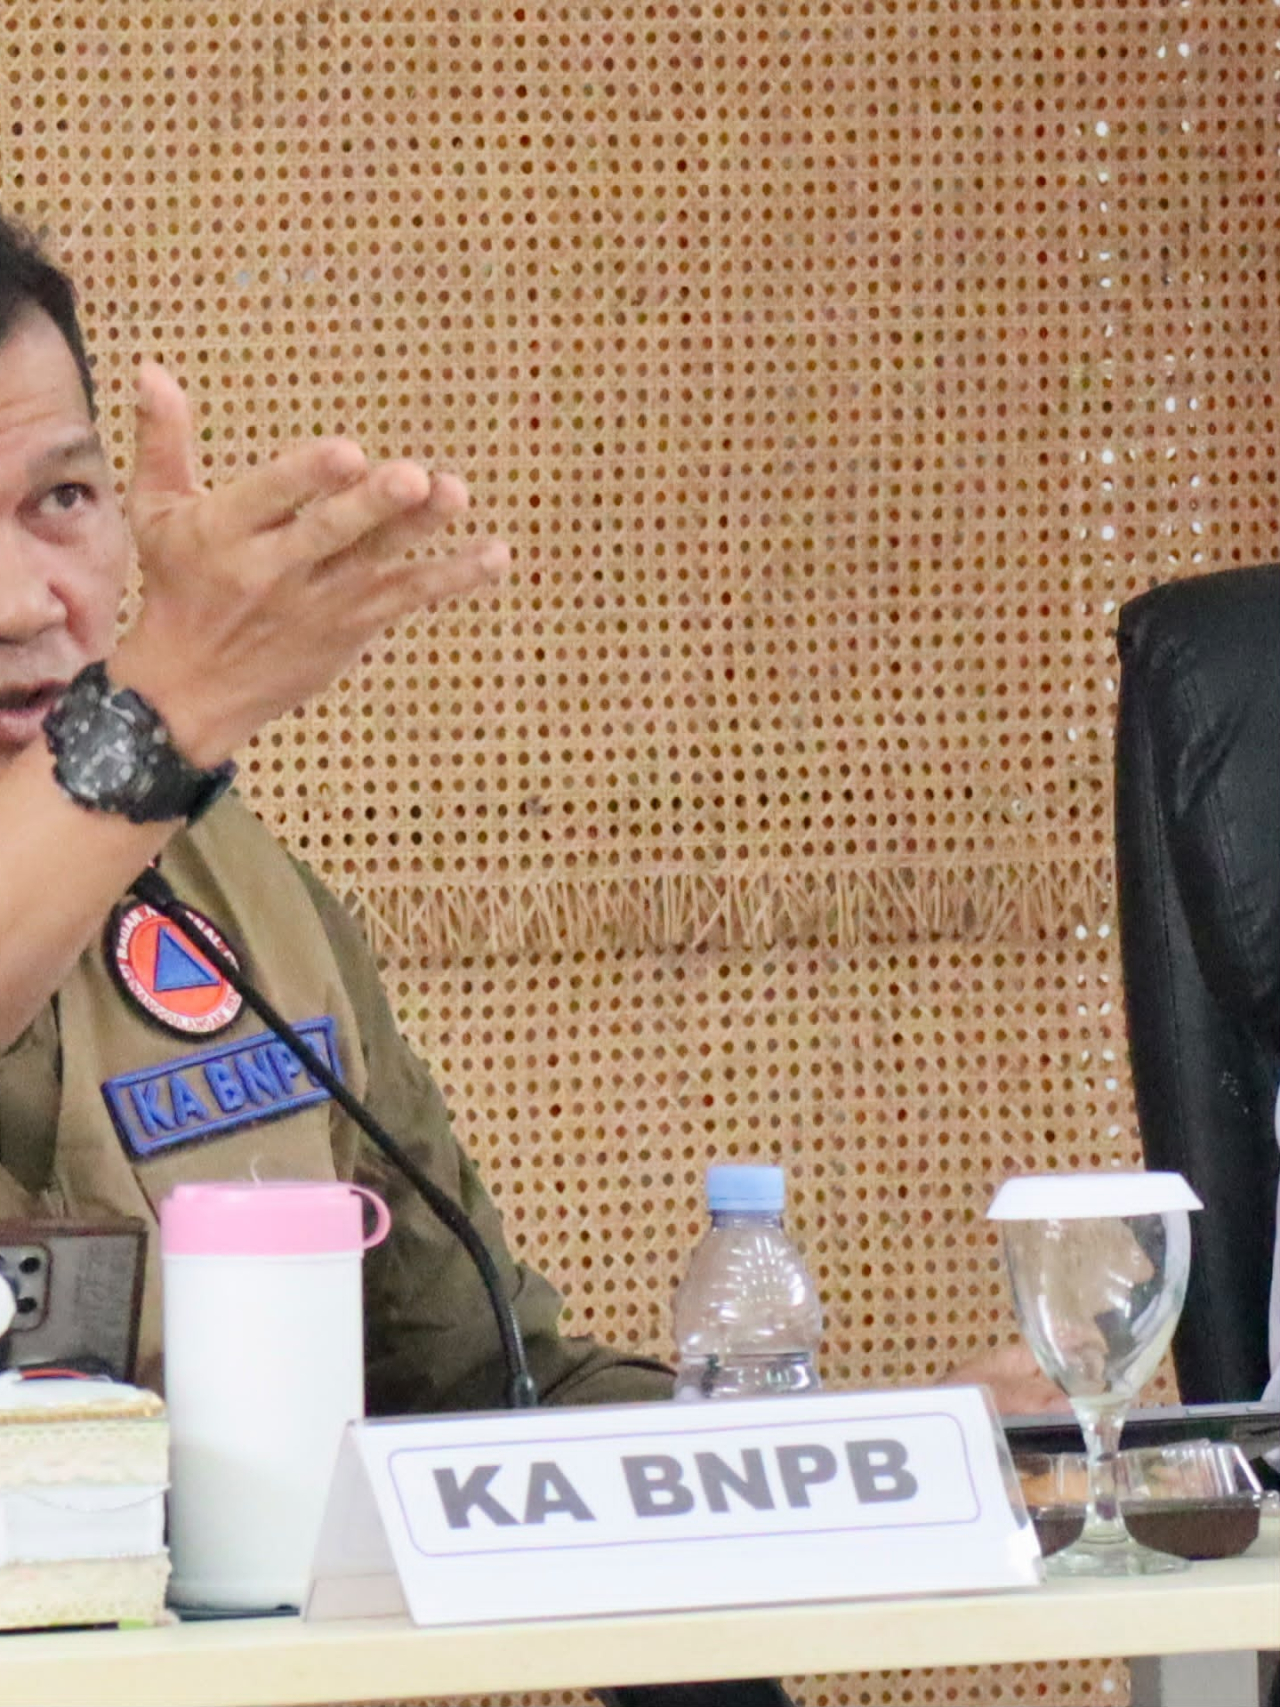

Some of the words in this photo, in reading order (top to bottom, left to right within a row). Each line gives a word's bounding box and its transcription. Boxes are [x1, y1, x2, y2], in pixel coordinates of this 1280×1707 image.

[128, 1073, 209, 1136] KA
[433, 1461, 595, 1529] KA
[620, 1440, 917, 1518] BNPB
